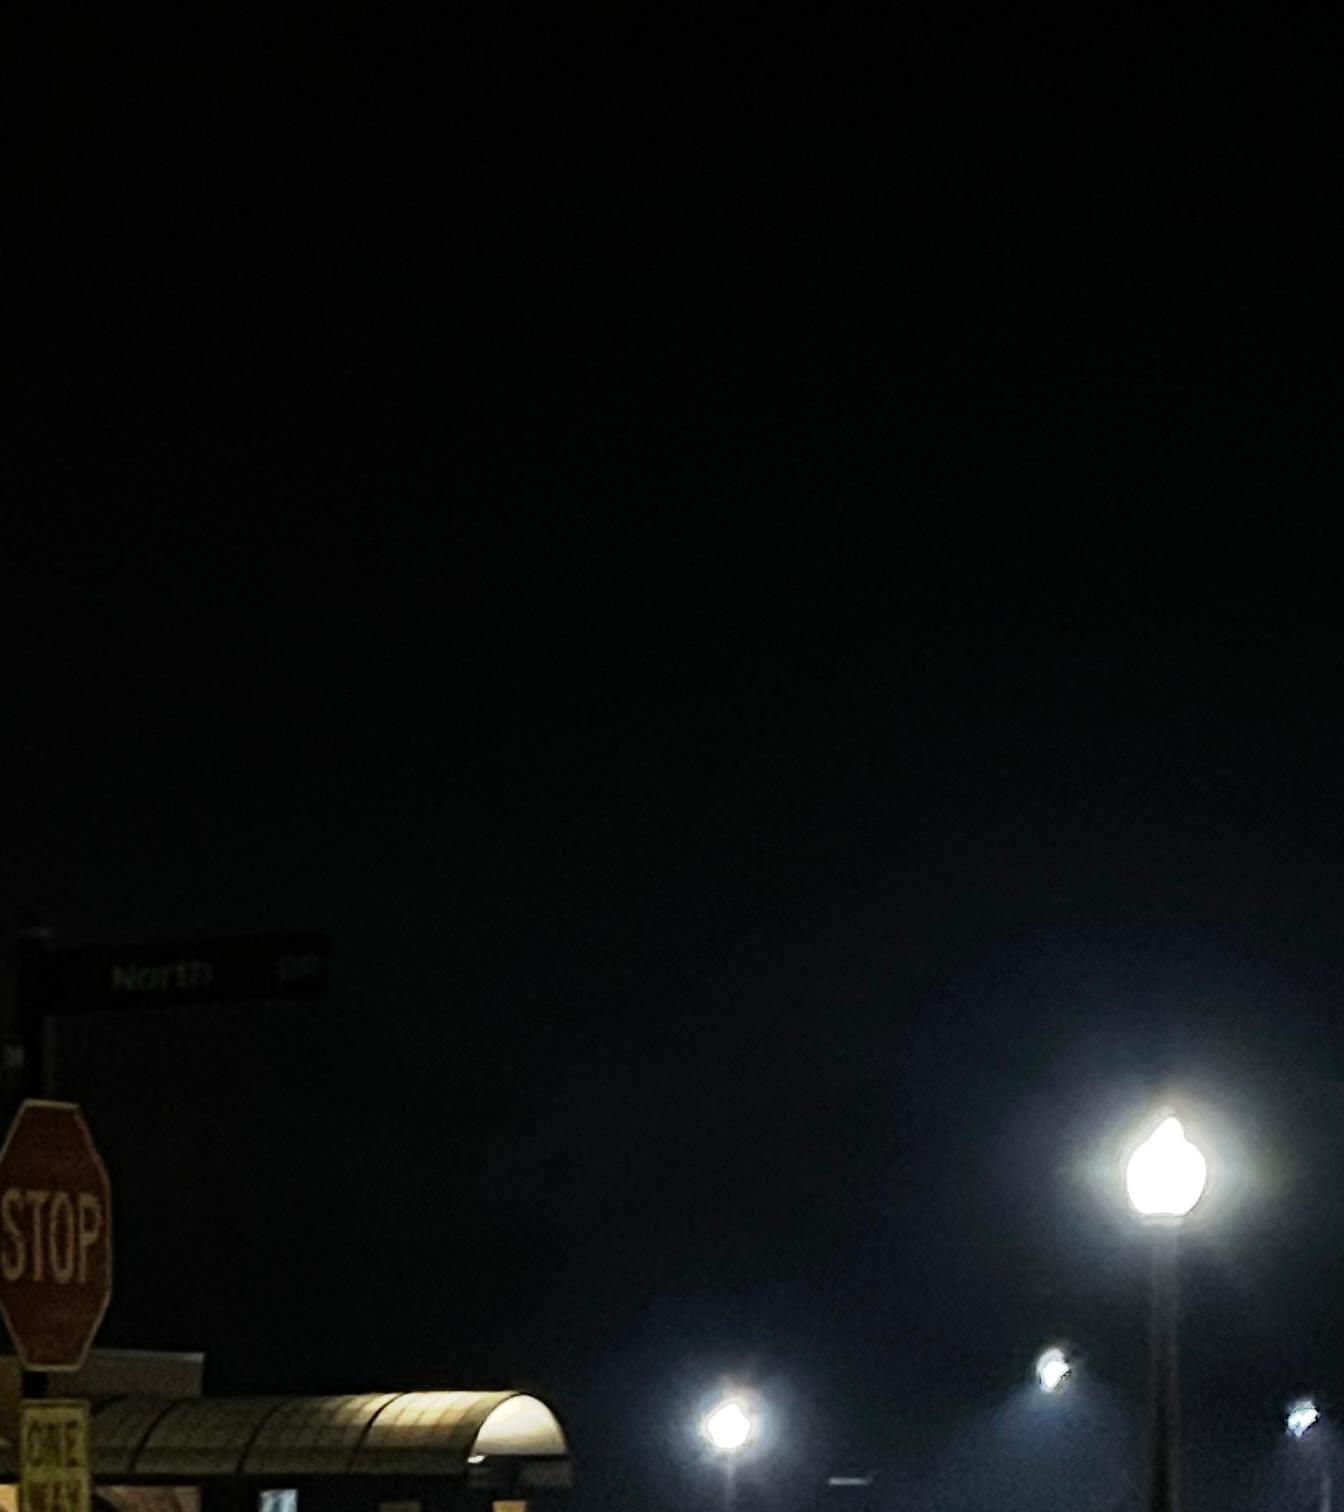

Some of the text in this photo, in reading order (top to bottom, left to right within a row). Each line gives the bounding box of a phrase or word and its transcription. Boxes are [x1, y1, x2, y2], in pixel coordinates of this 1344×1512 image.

[113, 959, 213, 990] North
[0, 1187, 102, 1284] STOP
[27, 1419, 78, 1468] ONE
